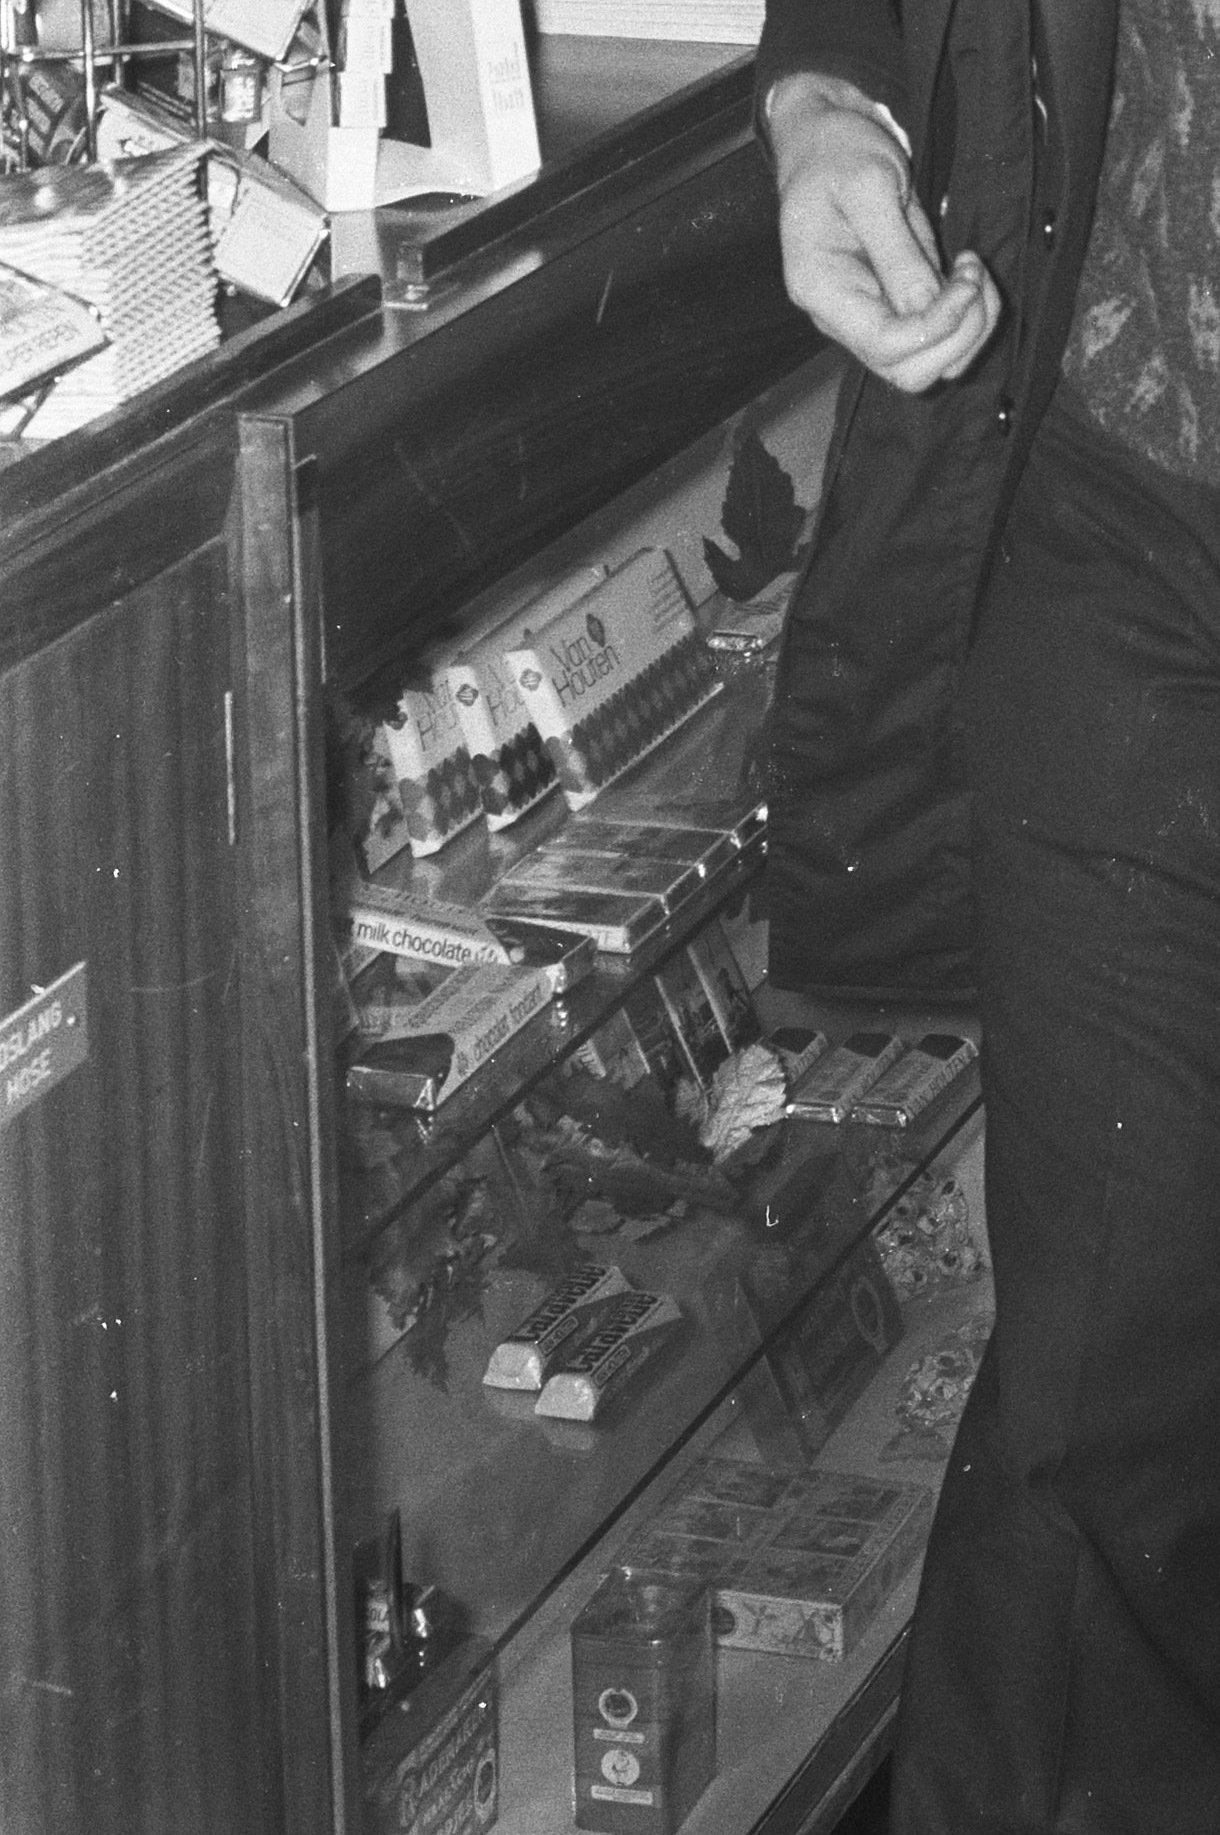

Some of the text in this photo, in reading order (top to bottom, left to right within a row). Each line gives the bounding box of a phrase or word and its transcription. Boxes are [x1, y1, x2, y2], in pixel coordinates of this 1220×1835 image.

[550, 635, 592, 673] Van
[554, 645, 620, 708] Houten
[357, 919, 471, 963] milk chocolate
